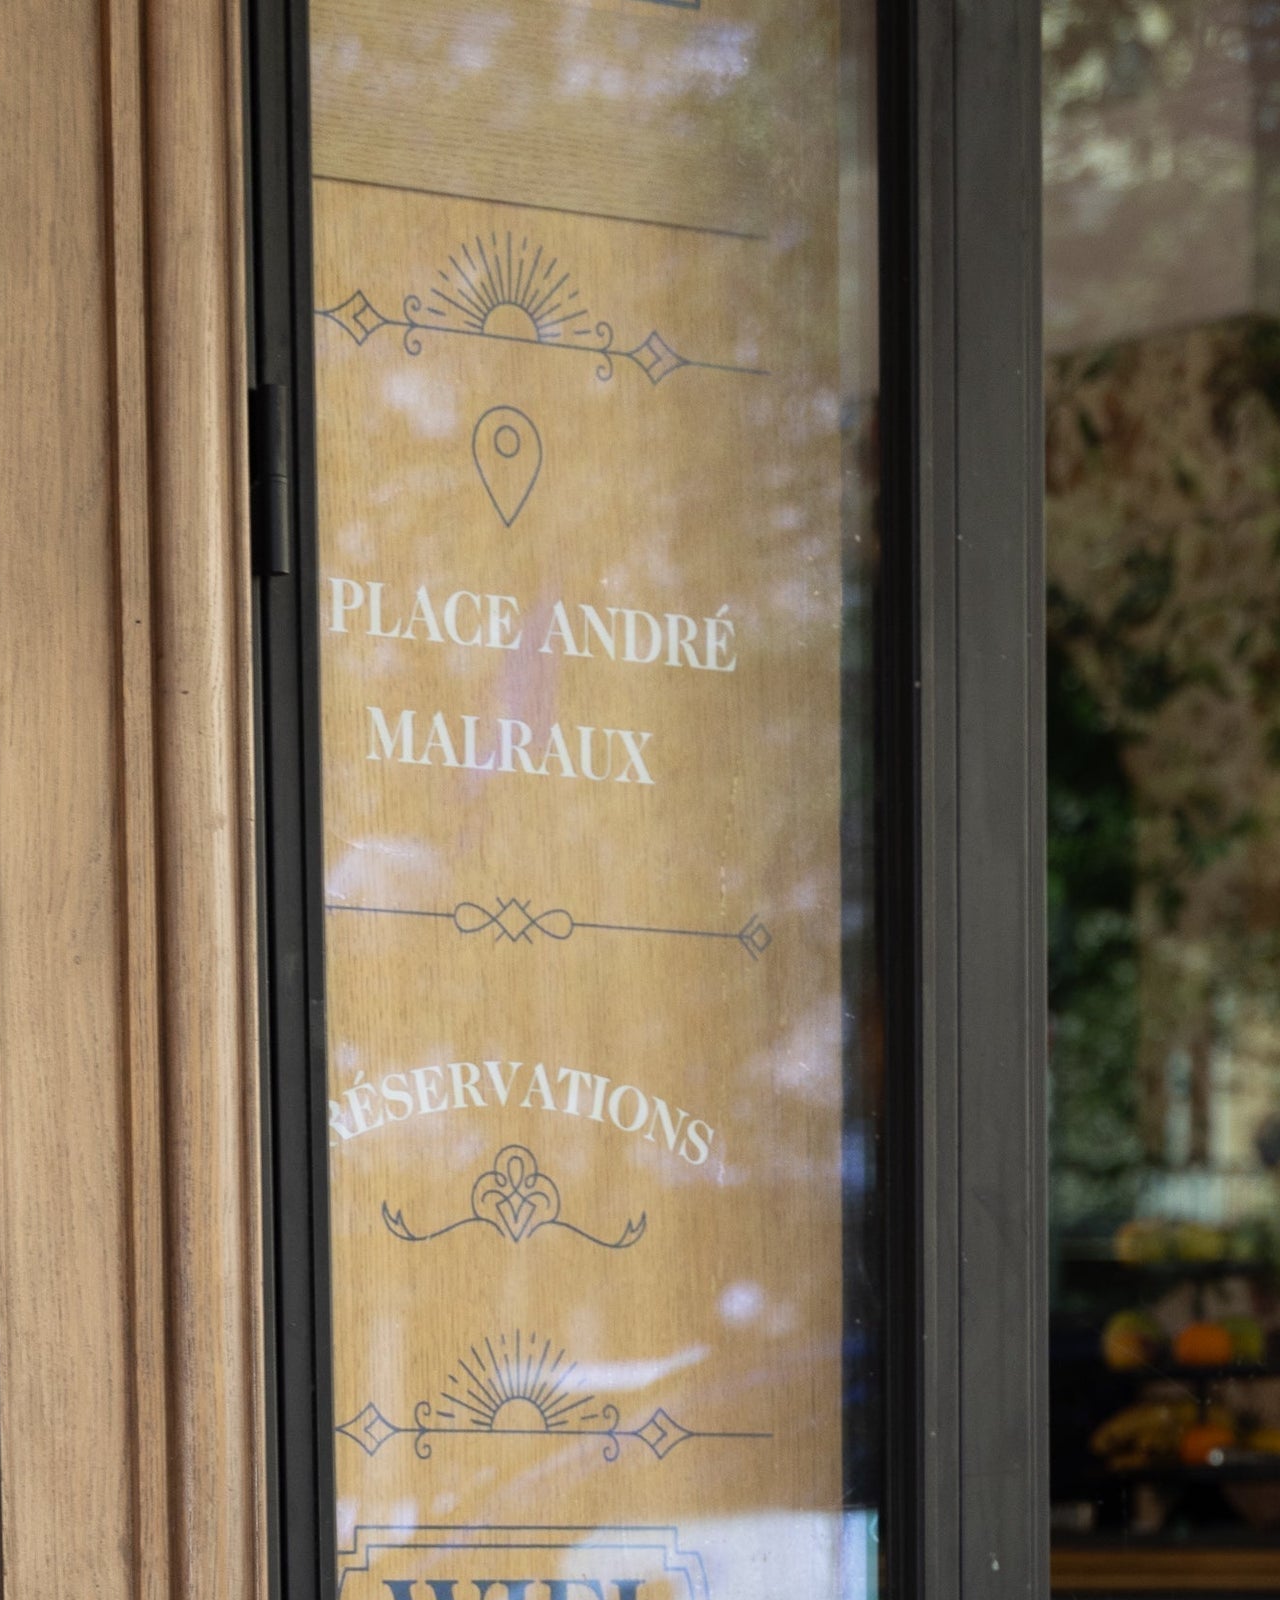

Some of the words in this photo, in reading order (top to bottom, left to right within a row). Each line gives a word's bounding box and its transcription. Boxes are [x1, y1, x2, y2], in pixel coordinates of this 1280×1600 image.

[328, 577, 521, 651] PLACE
[539, 600, 738, 672] ANDRÉ
[365, 705, 656, 785] MALRAUX
